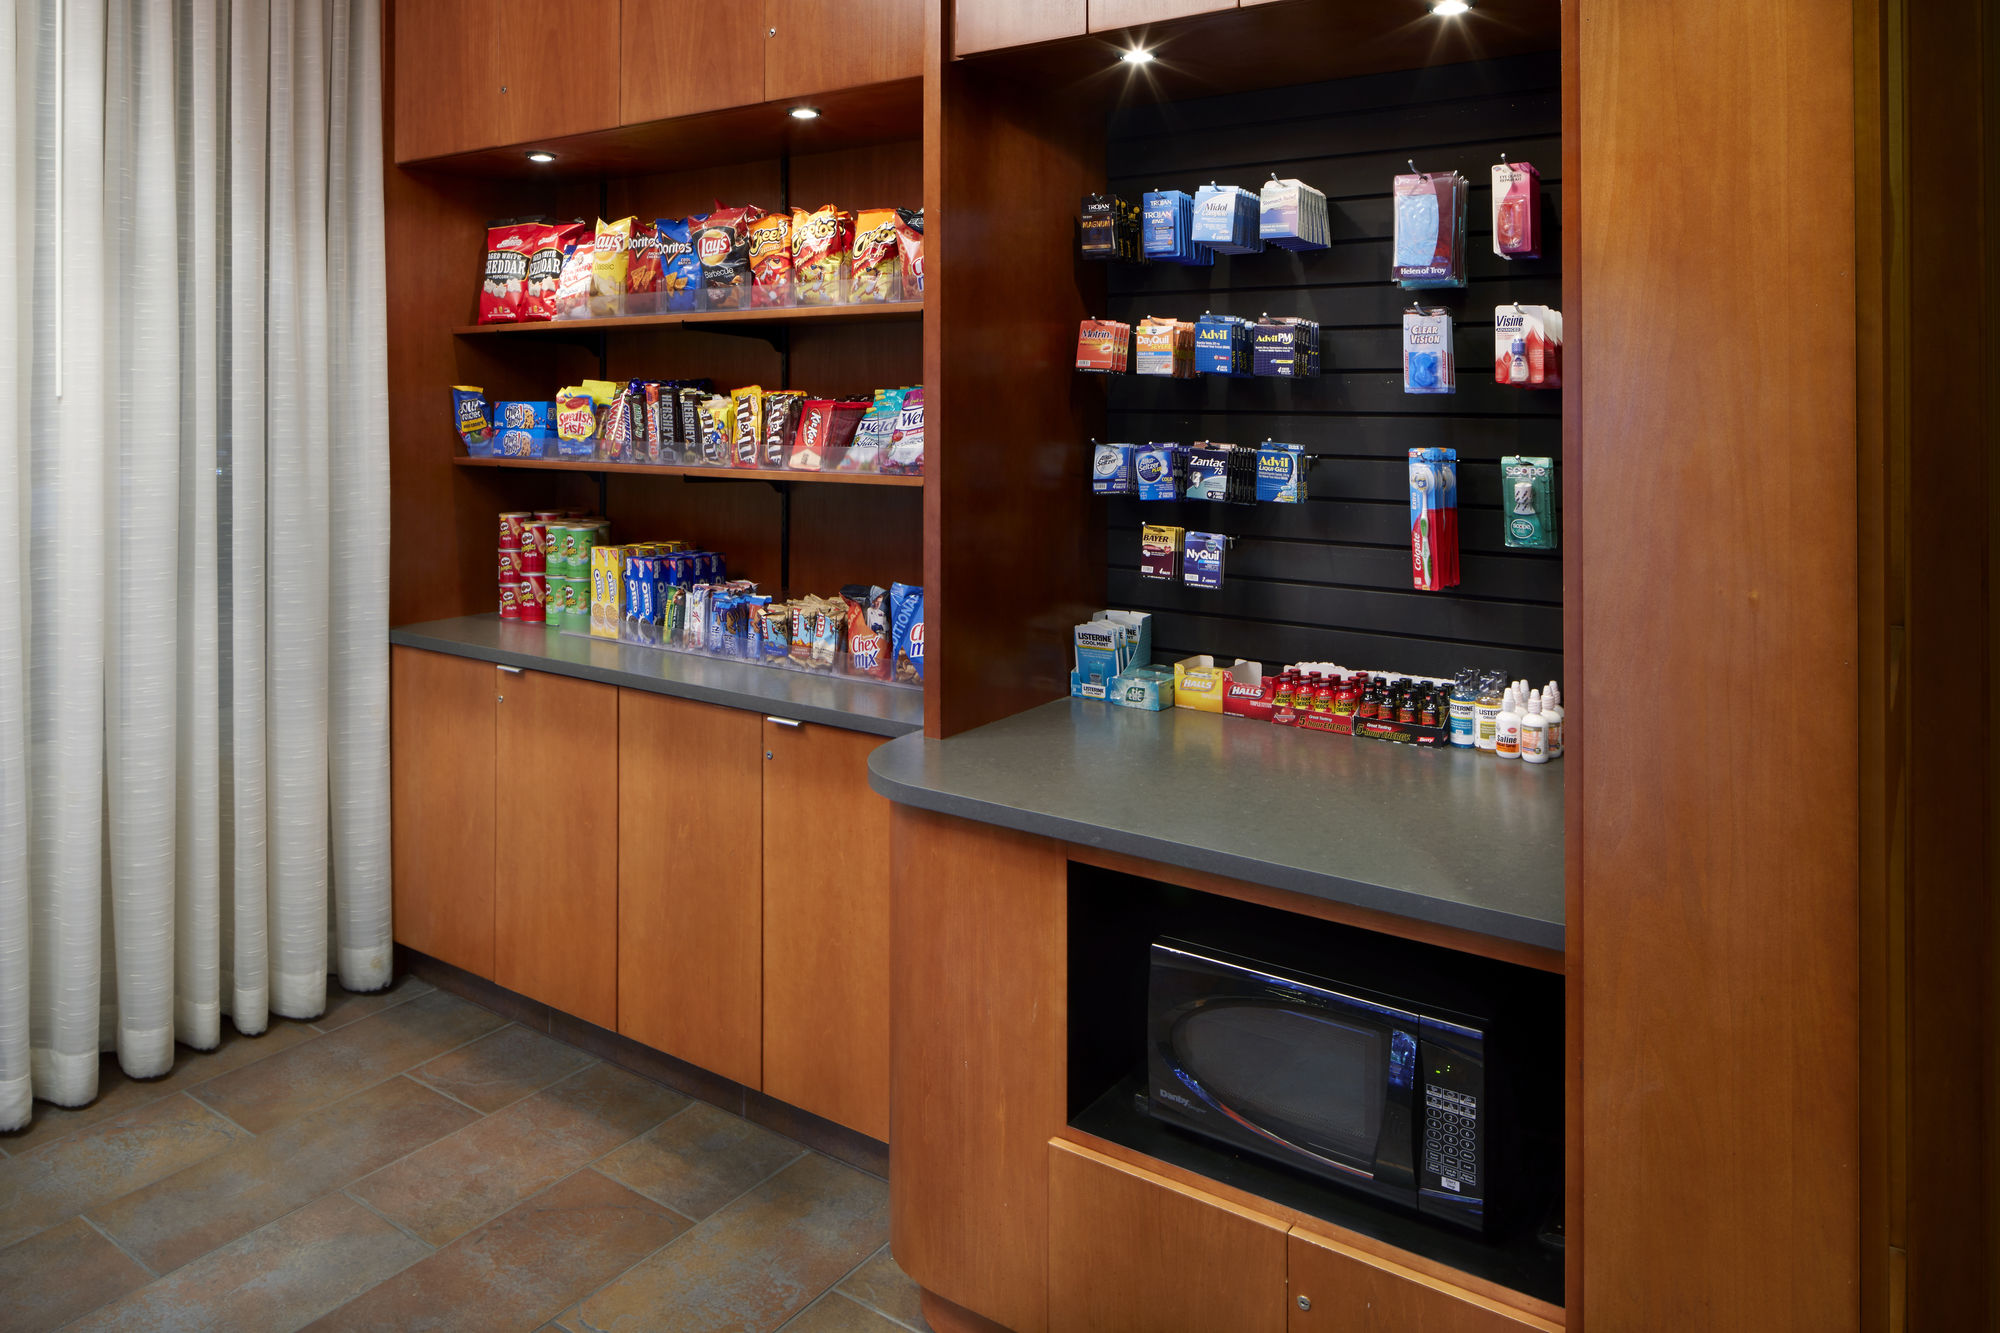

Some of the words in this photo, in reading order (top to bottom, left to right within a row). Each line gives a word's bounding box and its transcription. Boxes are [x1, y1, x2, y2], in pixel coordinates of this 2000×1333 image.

[1088, 202, 1110, 211] TROJAN
[1150, 199, 1173, 207] TROJAN
[1204, 202, 1228, 212] Midol
[1144, 210, 1173, 219] TROJAN
[1082, 219, 1111, 229] MAGNUM
[700, 236, 731, 258] Lay's
[501, 252, 522, 260] WHITE
[485, 259, 526, 276] HEDDAR
[704, 266, 734, 280] Barbecue
[1400, 267, 1420, 275] Helen
[1429, 267, 1446, 276] Troy
[1496, 315, 1524, 327] Visine
[1081, 329, 1111, 340] Motrin
[1199, 329, 1228, 340] Advil
[1411, 325, 1439, 335] CLEAR
[1137, 336, 1170, 346] DayQuil
[1256, 335, 1278, 343] Advil
[1277, 332, 1292, 343] PM
[559, 410, 593, 427] Swedish
[661, 394, 675, 446] HERSHEY'S
[563, 422, 586, 436] Fish
[1097, 458, 1117, 467] Seltzer
[1139, 461, 1160, 472] Seltzer
[1190, 455, 1226, 468] Zantac
[1258, 455, 1290, 468] Advil
[1213, 467, 1223, 475] 75
[1505, 465, 1546, 479] scope
[1143, 534, 1169, 543] BAYER
[1186, 548, 1220, 562] NyQuil
[1414, 532, 1422, 571] Colgate
[893, 594, 920, 652] DITIONAL
[851, 633, 879, 652] Chex
[1077, 632, 1112, 644] LISTERINE
[853, 649, 879, 670] mix
[1083, 685, 1105, 694] LISTERINE
[1183, 679, 1213, 689] HALLS
[1231, 686, 1263, 697] HALLS
[1478, 708, 1499, 717] LISTER
[1323, 721, 1351, 733] ENERGY
[1496, 734, 1518, 744] Saline
[1159, 1088, 1190, 1107] Danby
